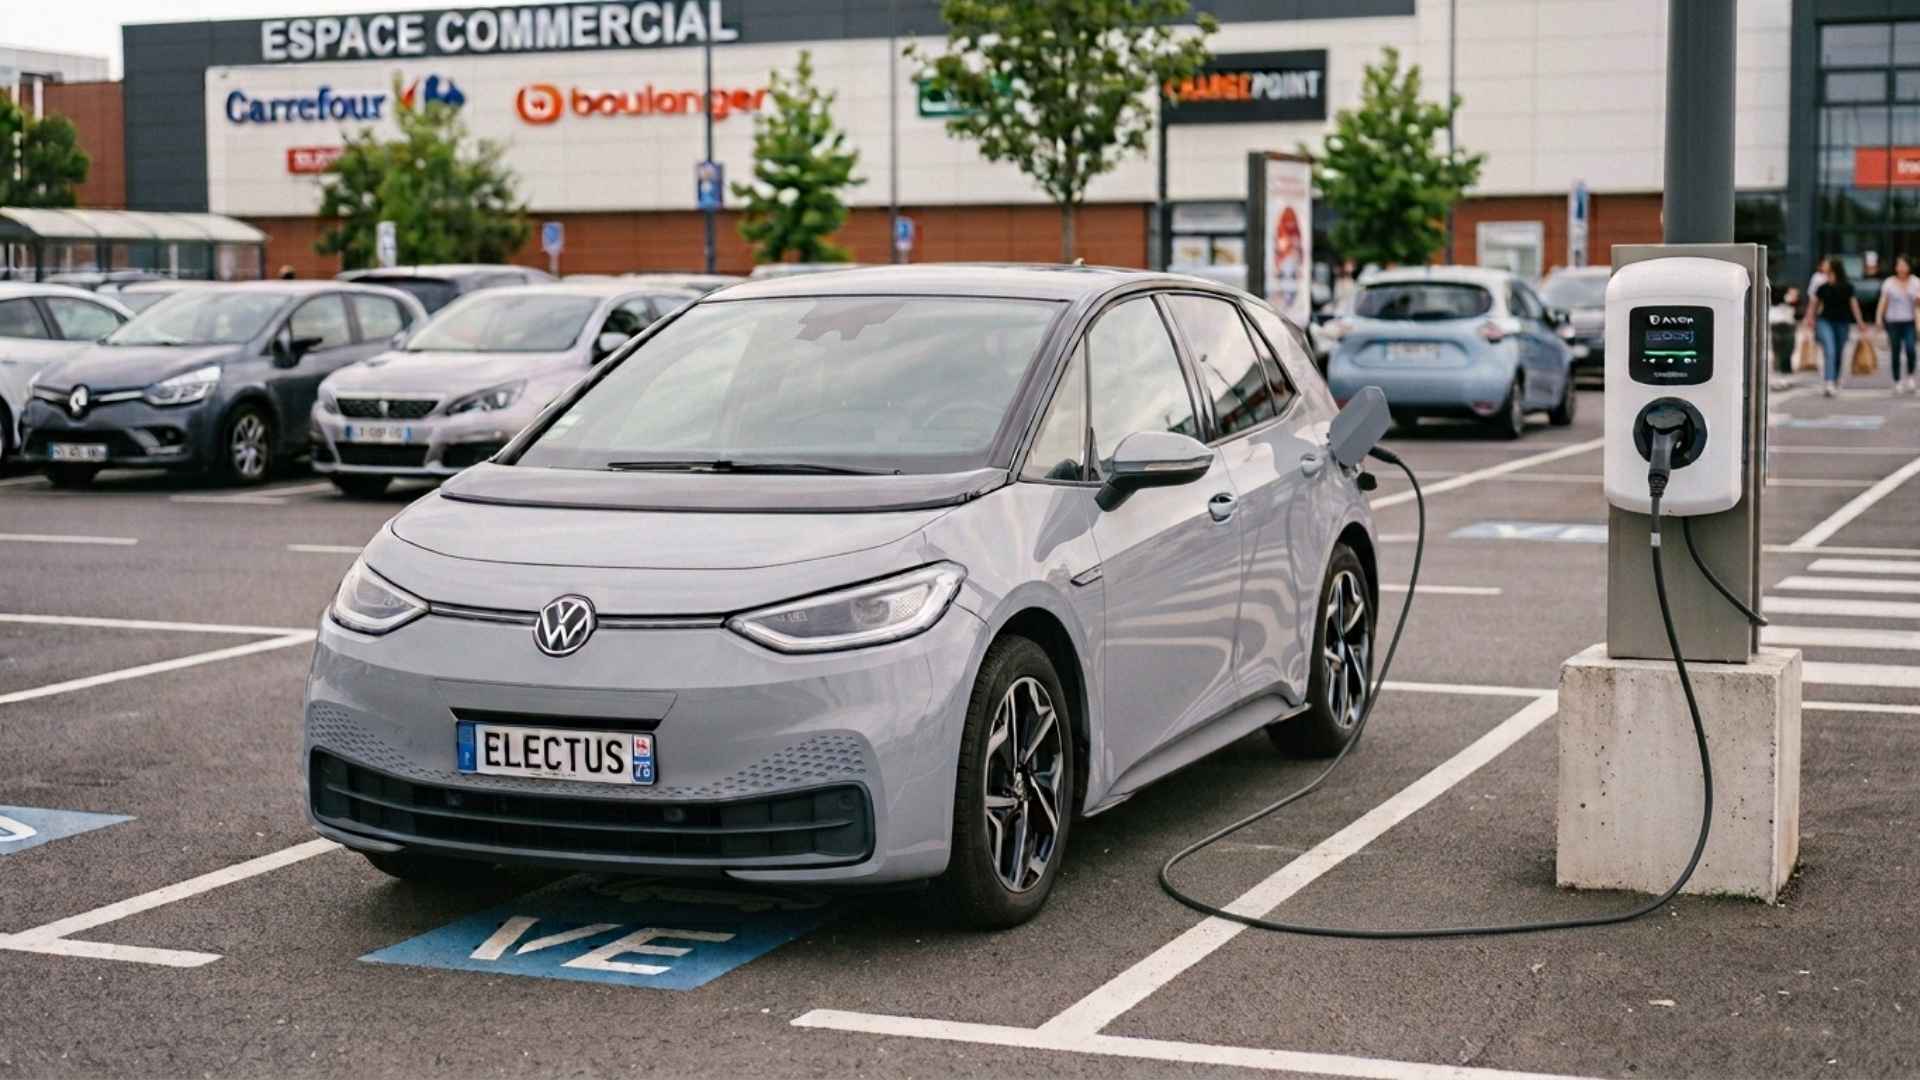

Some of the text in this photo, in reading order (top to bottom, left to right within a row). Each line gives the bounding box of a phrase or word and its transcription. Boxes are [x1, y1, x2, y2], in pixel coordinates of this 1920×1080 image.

[261, 0, 738, 61] ESPACE COMMERCIAL
[226, 85, 386, 124] Carrefour
[571, 83, 767, 121] boulanger
[536, 598, 590, 652] VW
[485, 731, 624, 774] ELECTUS
[469, 915, 736, 976] VE
